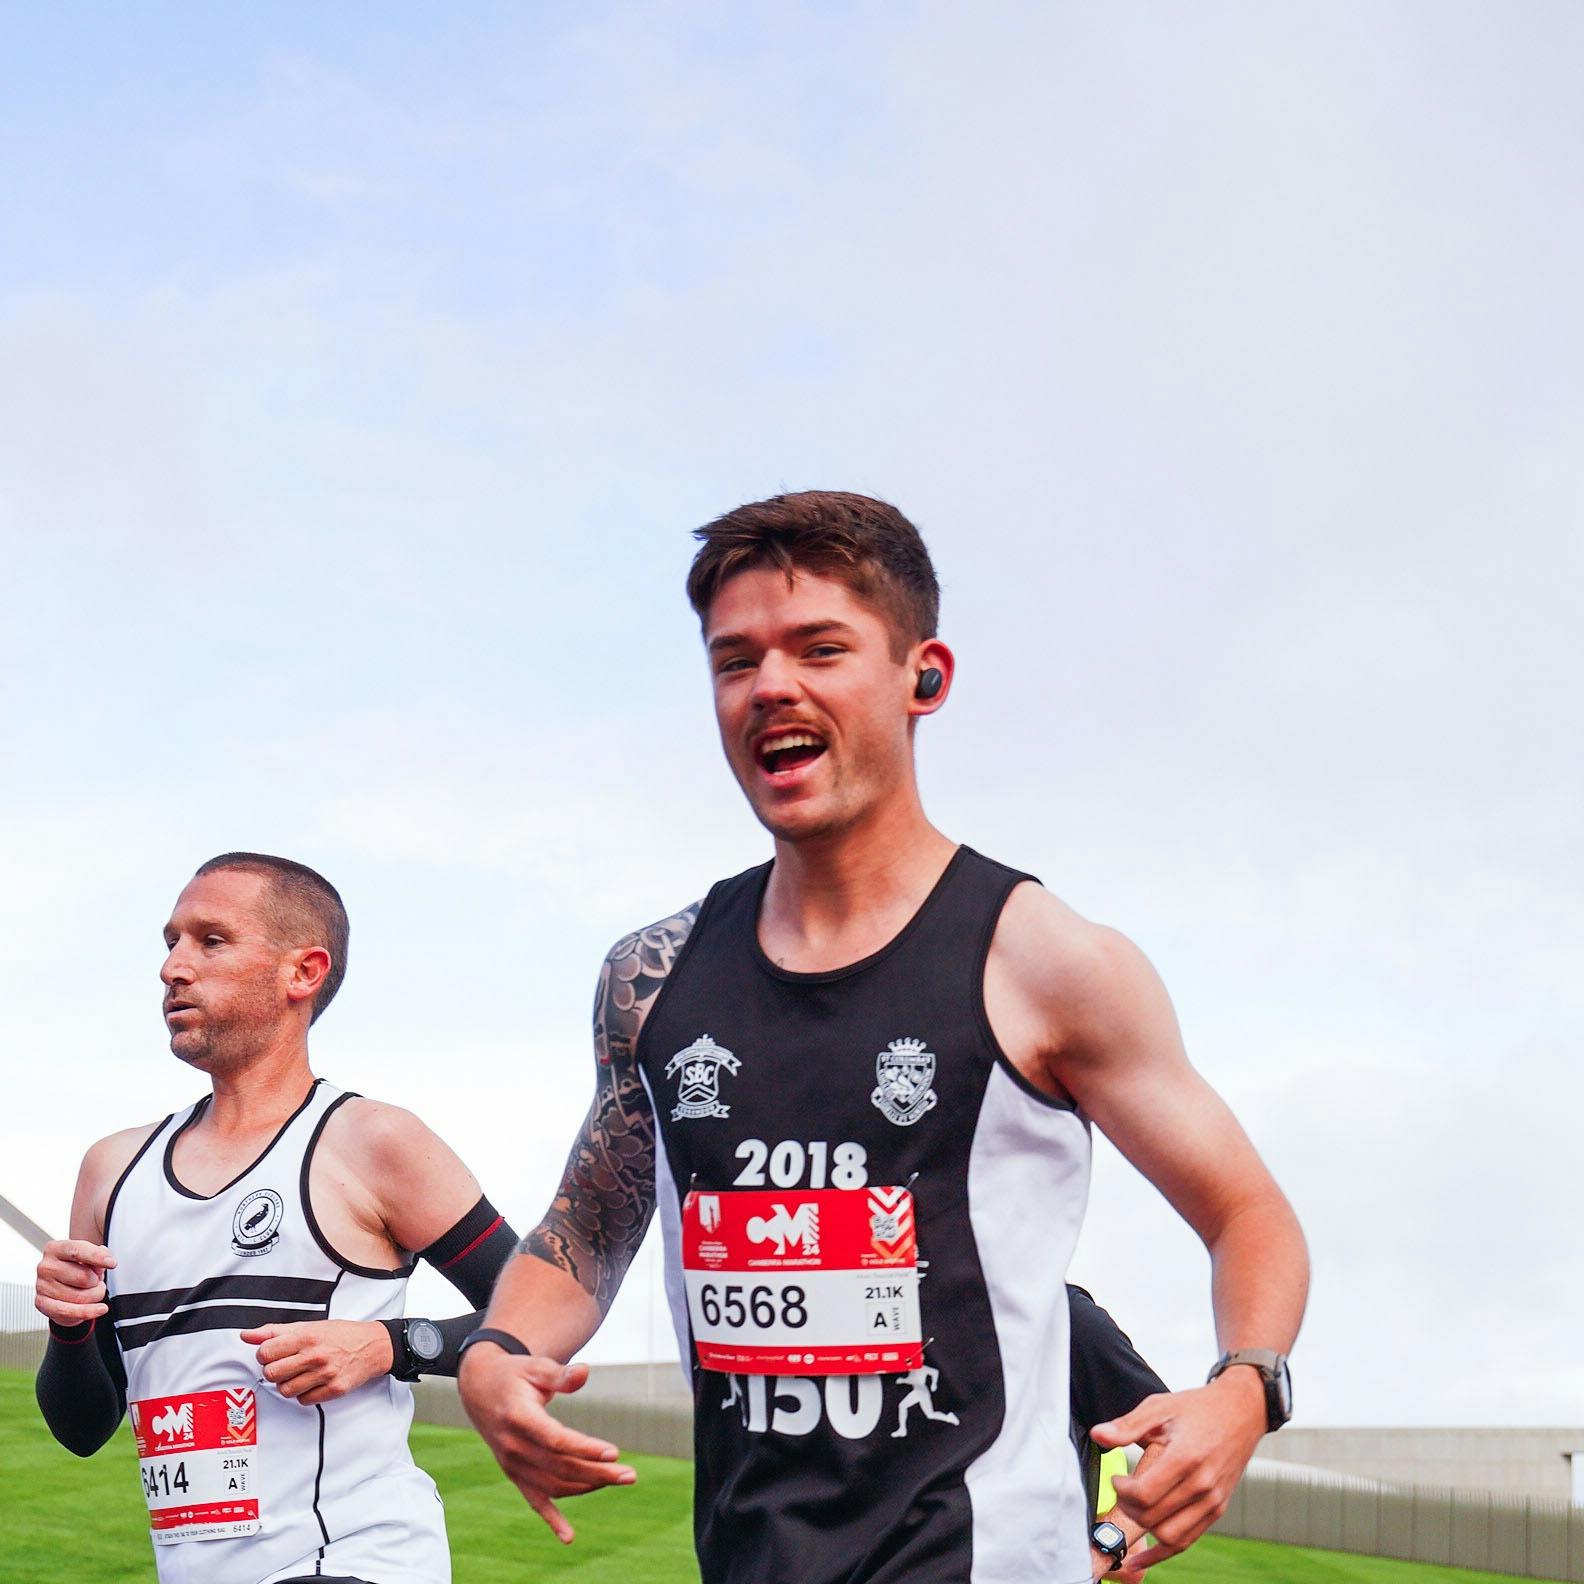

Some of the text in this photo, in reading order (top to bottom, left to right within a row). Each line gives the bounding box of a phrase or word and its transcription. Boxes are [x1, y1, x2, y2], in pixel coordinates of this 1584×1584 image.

[684, 1063, 715, 1086] SBC
[732, 1138, 868, 1191] 2018
[802, 1244, 820, 1256] 24
[701, 1284, 904, 1329] 6568 21.1K
[874, 1312, 887, 1328] A
[747, 1374, 883, 1440] 150
[141, 1458, 249, 1498] 6414 21.1K
[228, 1478, 238, 1490] A
